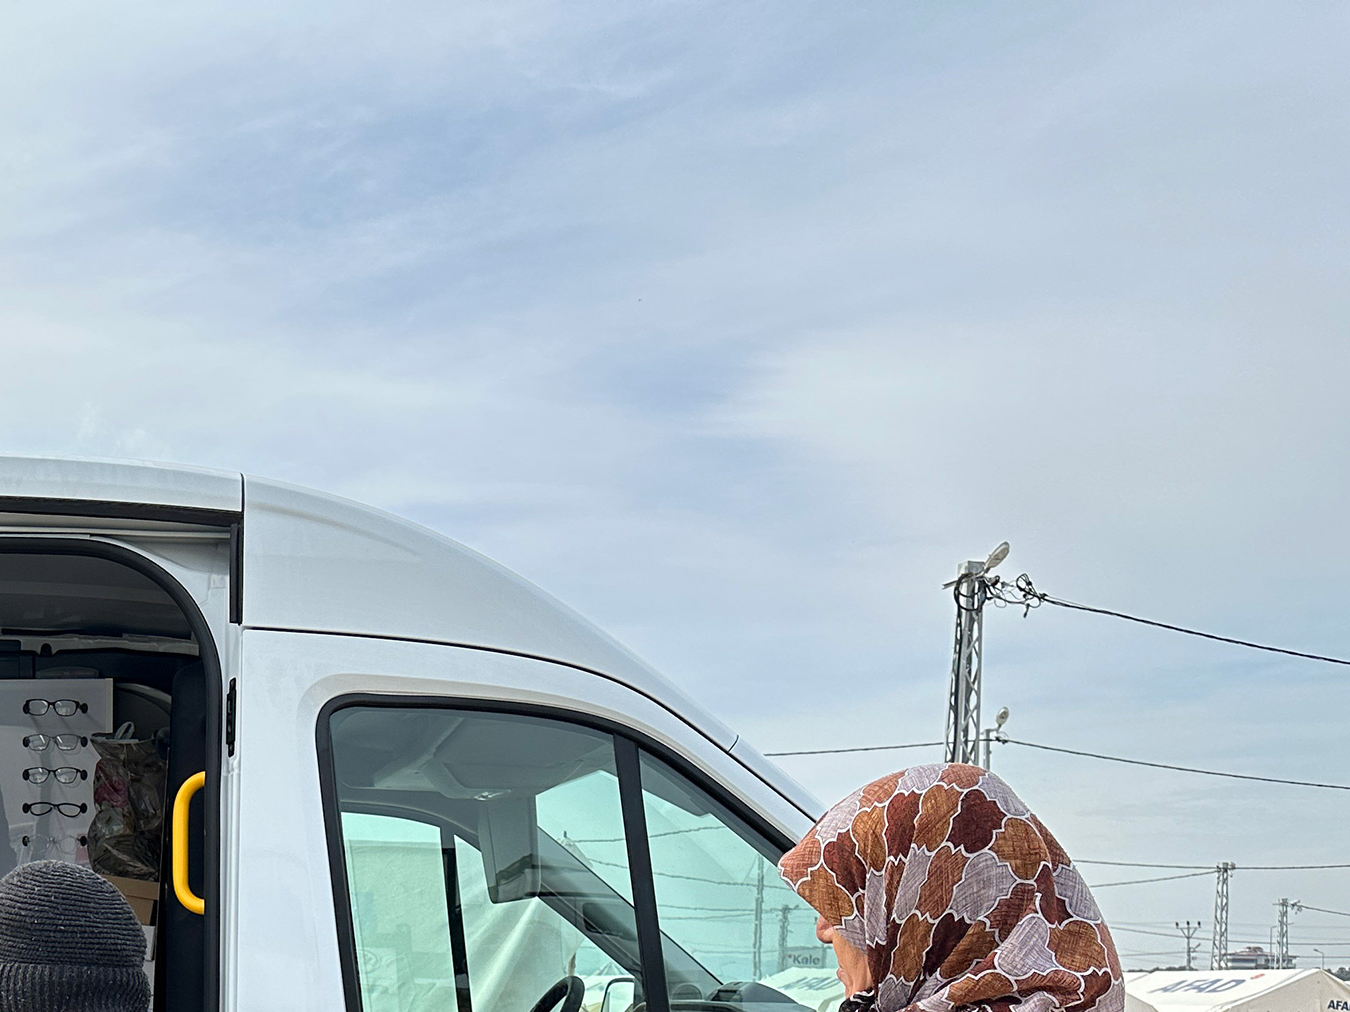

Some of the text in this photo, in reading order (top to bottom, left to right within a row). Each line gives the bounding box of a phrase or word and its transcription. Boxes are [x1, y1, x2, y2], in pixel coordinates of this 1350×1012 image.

[792, 953, 820, 965] Kale
[1147, 978, 1247, 993] AFAD
[1327, 1000, 1350, 1011] AFA
